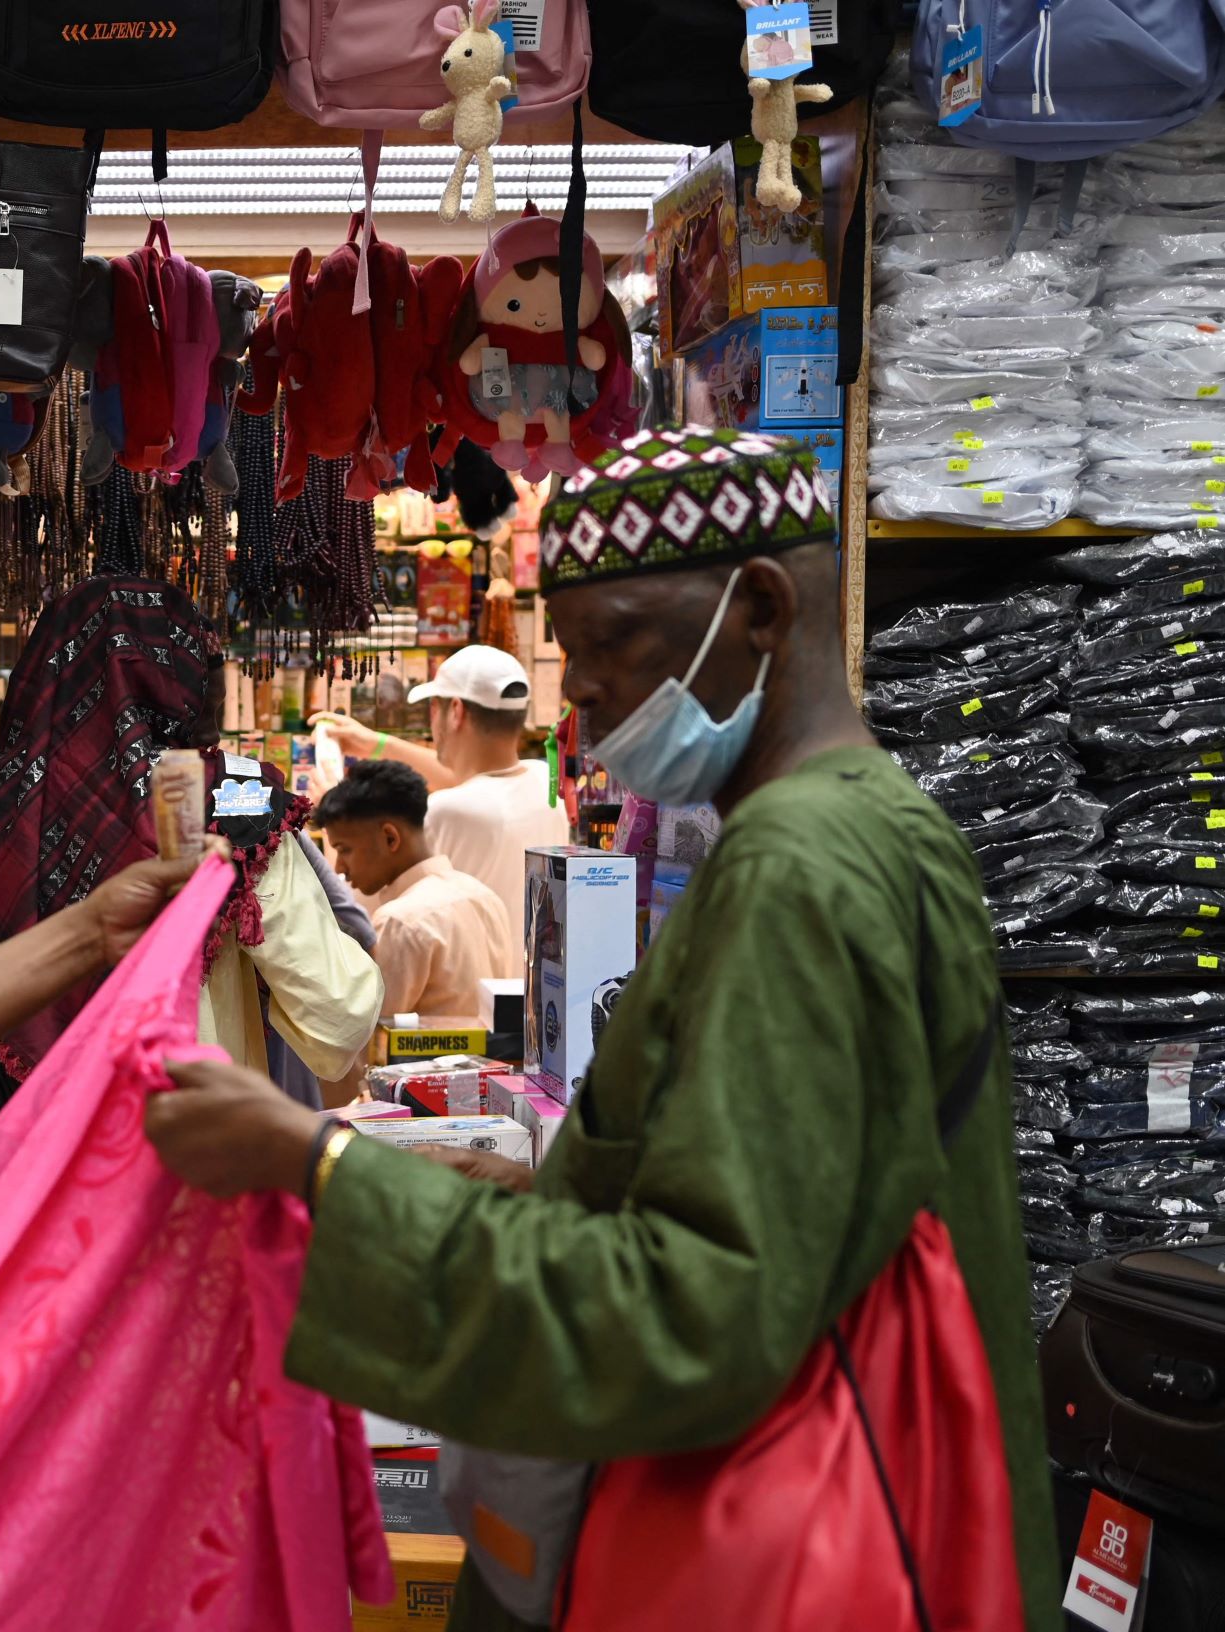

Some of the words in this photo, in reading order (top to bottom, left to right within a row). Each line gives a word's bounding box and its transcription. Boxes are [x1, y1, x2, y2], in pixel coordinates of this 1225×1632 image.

[90, 21, 146, 40] XLFENG
[755, 18, 801, 30] BRILLANT
[947, 46, 978, 69] BRILLANT
[587, 867, 613, 875] R/C
[397, 1035, 469, 1052] SHARPNESS
